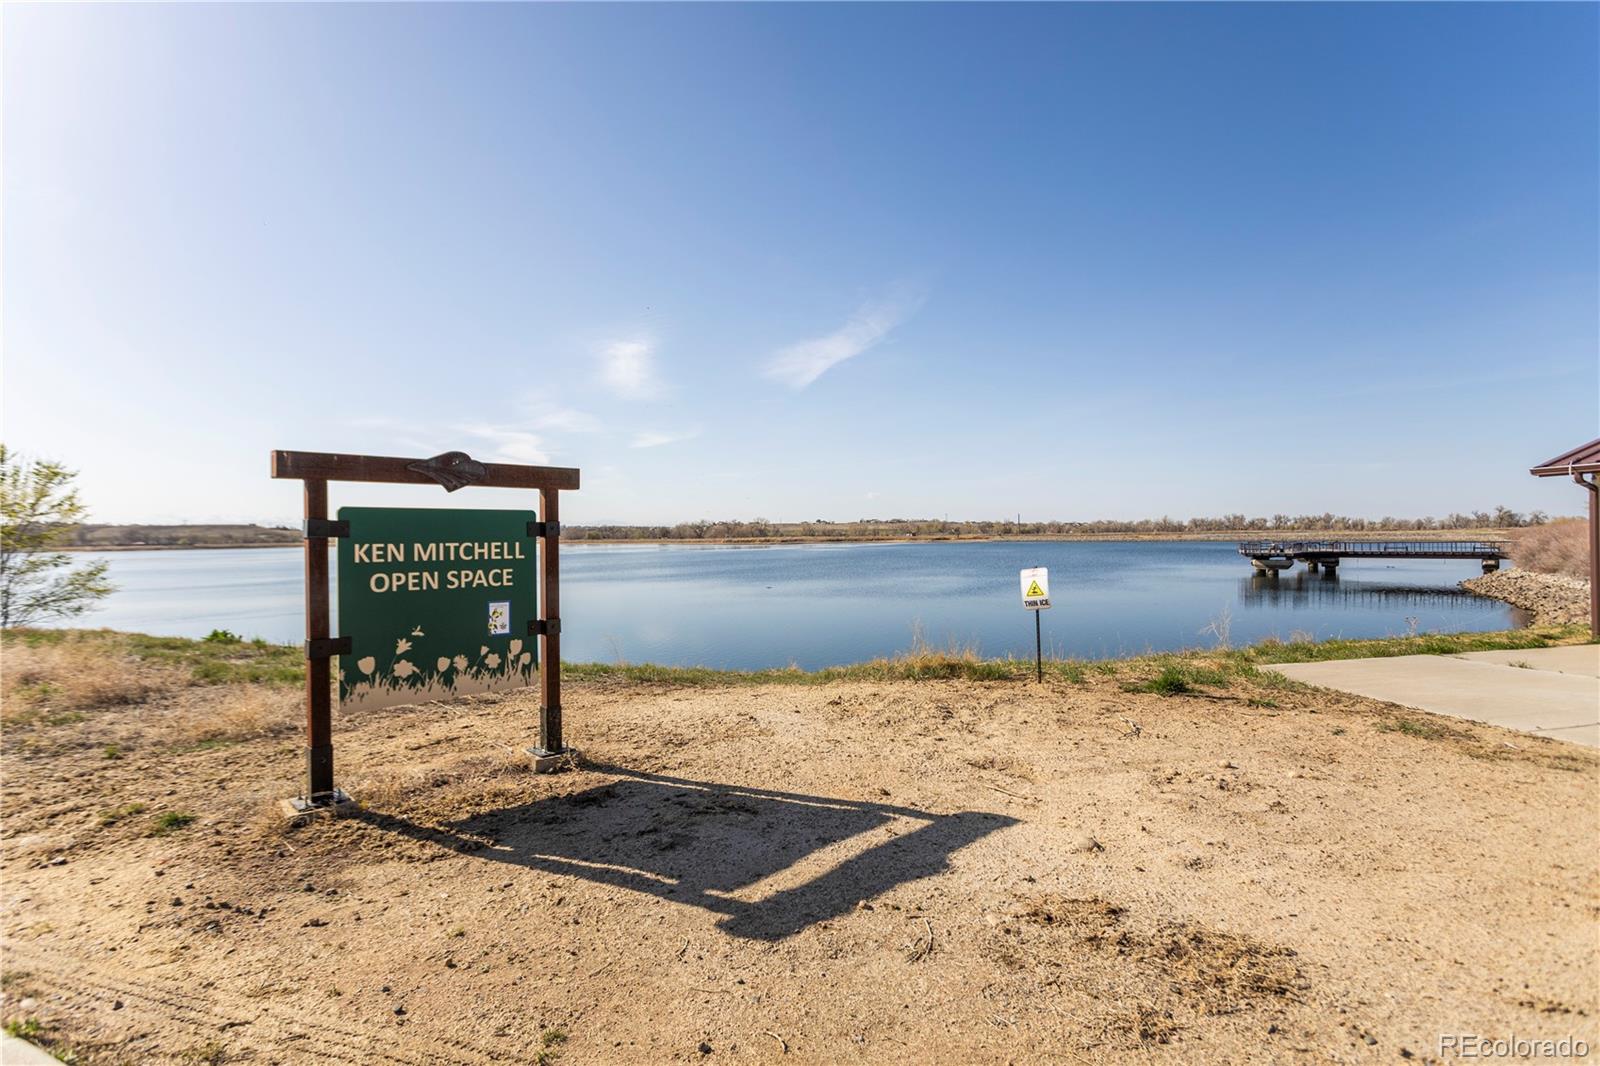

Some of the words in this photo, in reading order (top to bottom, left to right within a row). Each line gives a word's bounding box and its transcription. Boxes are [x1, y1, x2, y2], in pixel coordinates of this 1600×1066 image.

[353, 543, 405, 563] KEN
[413, 541, 526, 562] MITCHELL
[369, 571, 439, 593] OPEN
[446, 568, 514, 589] SPACE
